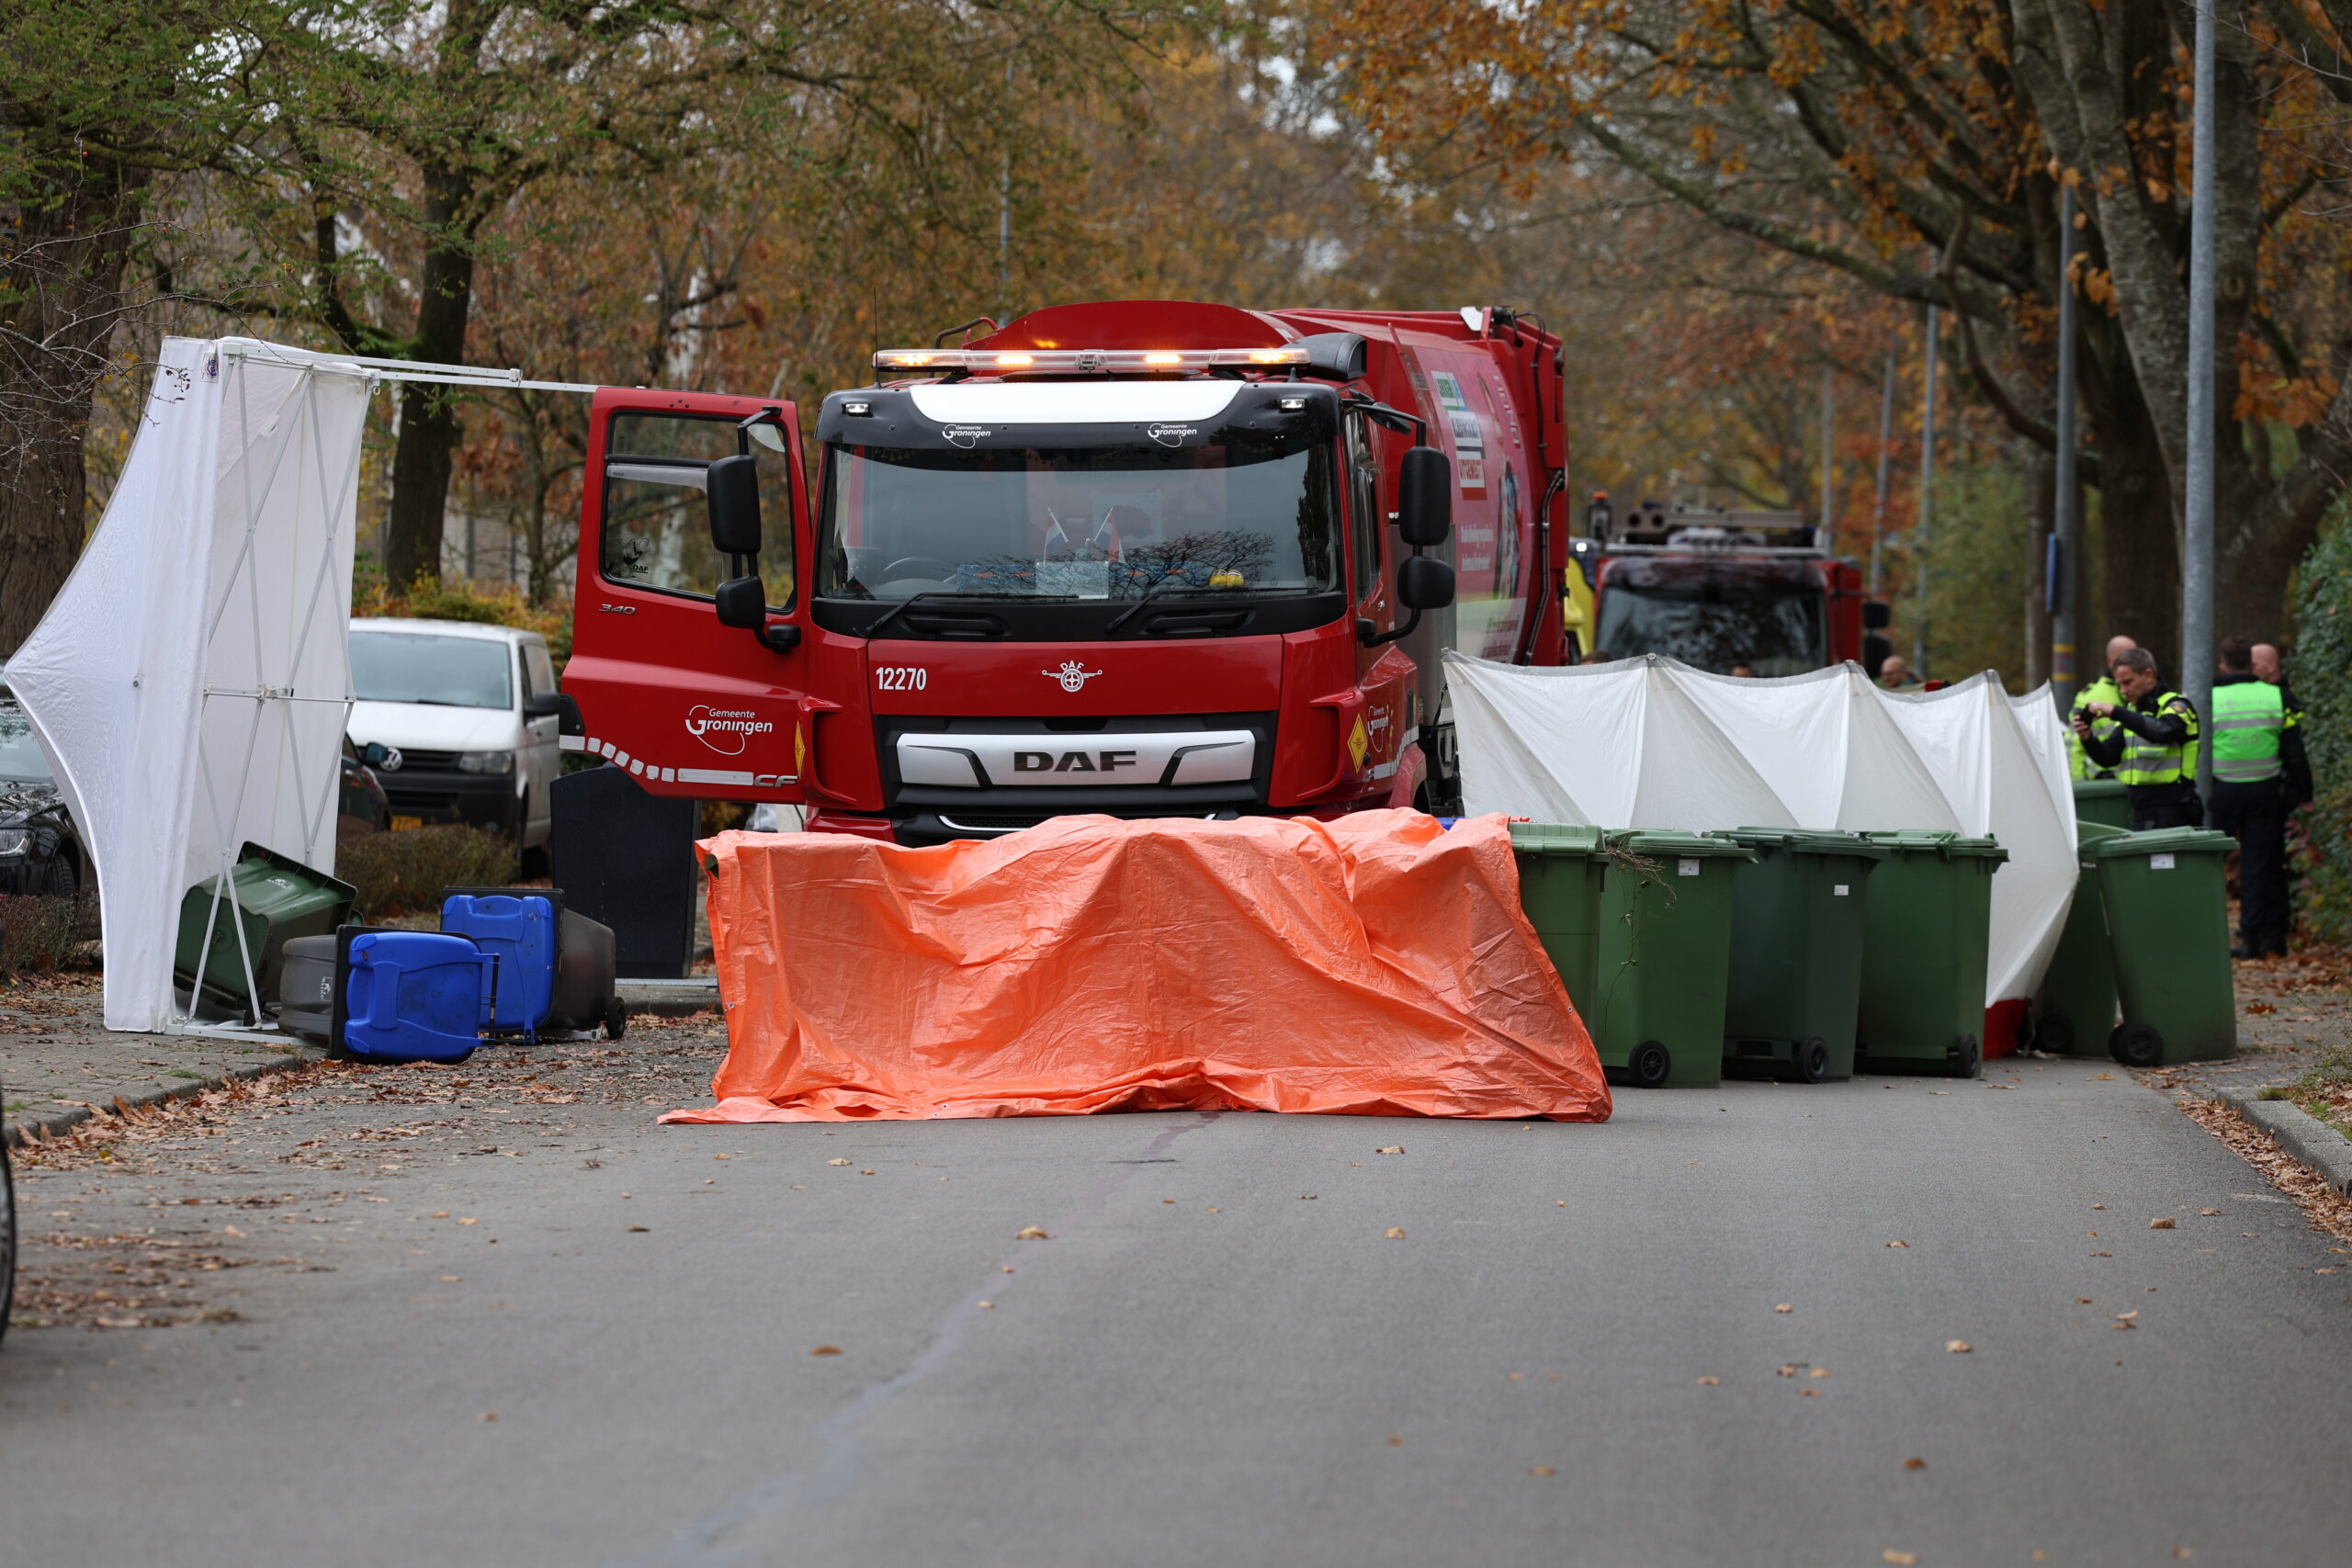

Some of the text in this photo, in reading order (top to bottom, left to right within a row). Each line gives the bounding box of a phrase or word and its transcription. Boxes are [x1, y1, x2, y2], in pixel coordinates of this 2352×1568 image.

[942, 430, 991, 439] Groningen
[1148, 429, 1197, 438] Groningen
[632, 564, 650, 572] DAF
[598, 604, 637, 616] 340
[1059, 660, 1085, 671] DAF
[876, 666, 928, 691] 12270
[708, 707, 756, 719] Gemeente
[684, 718, 774, 736] Groningen
[1013, 749, 1138, 773] DAF
[753, 774, 798, 788] CF
